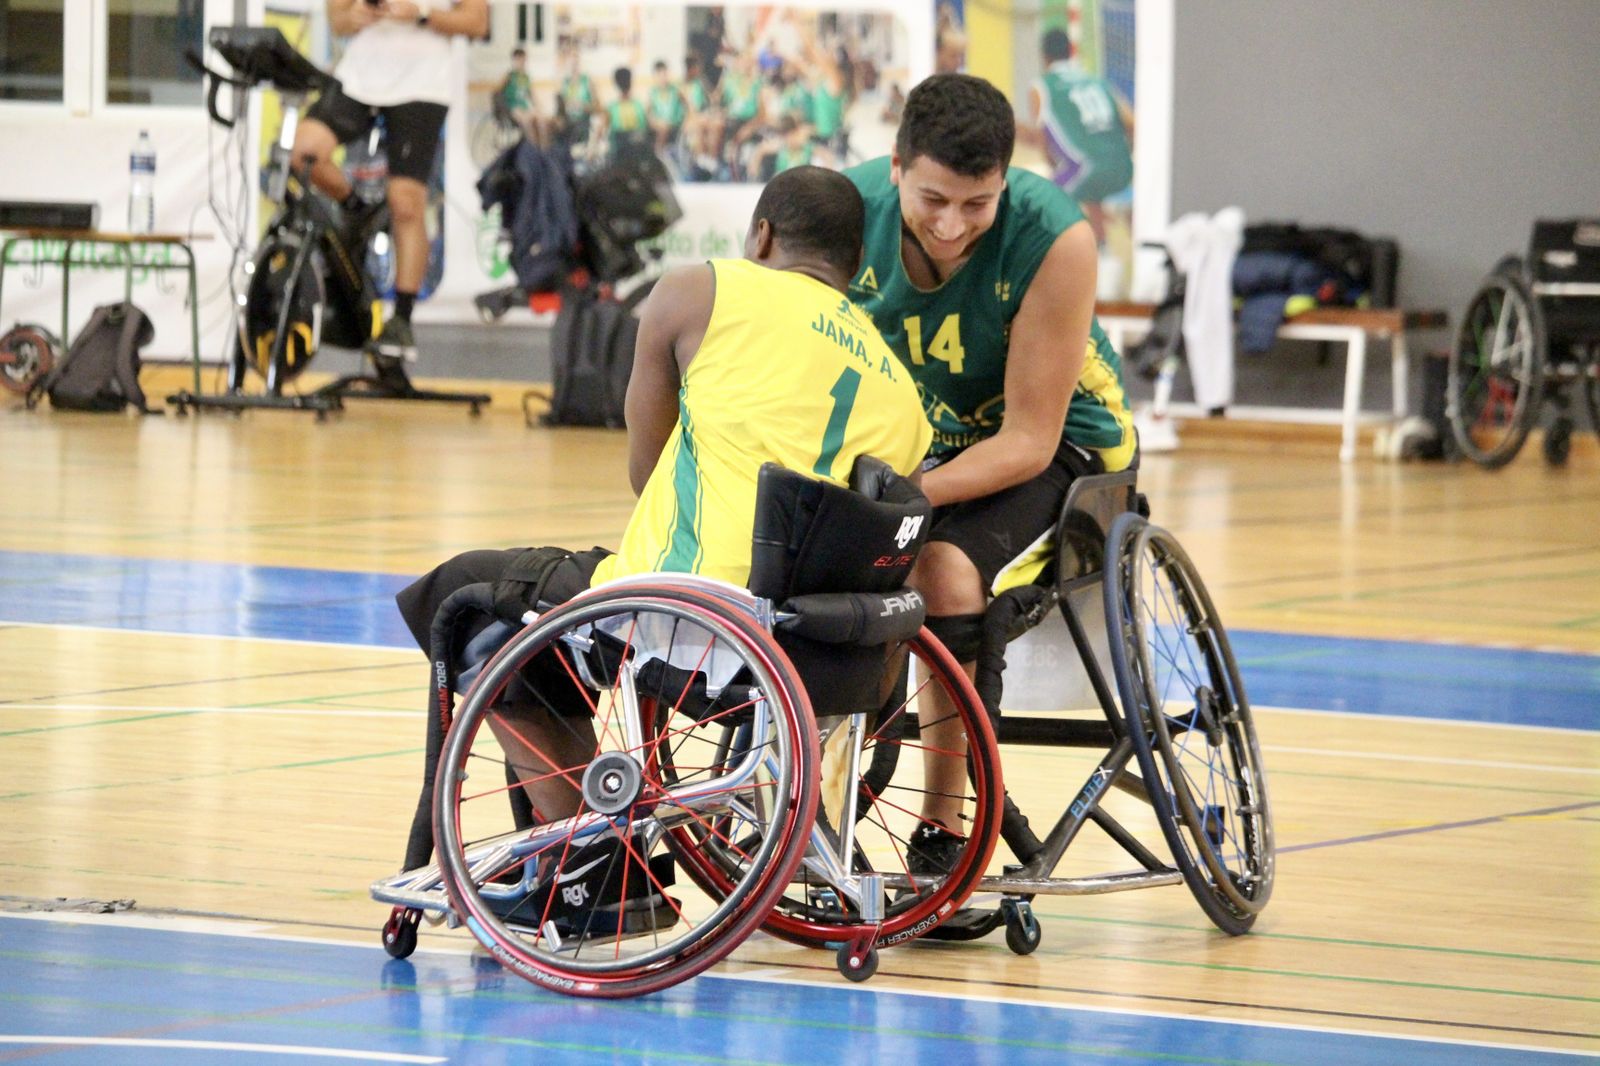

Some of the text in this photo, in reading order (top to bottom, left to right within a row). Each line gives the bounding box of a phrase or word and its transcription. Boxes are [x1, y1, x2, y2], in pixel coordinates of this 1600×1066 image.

[903, 313, 965, 374] 14
[880, 355, 897, 383] A.
[813, 366, 862, 478] 1
[874, 554, 913, 567] ELITE
[880, 591, 922, 617] JAMA
[888, 913, 938, 944] EXERACER
